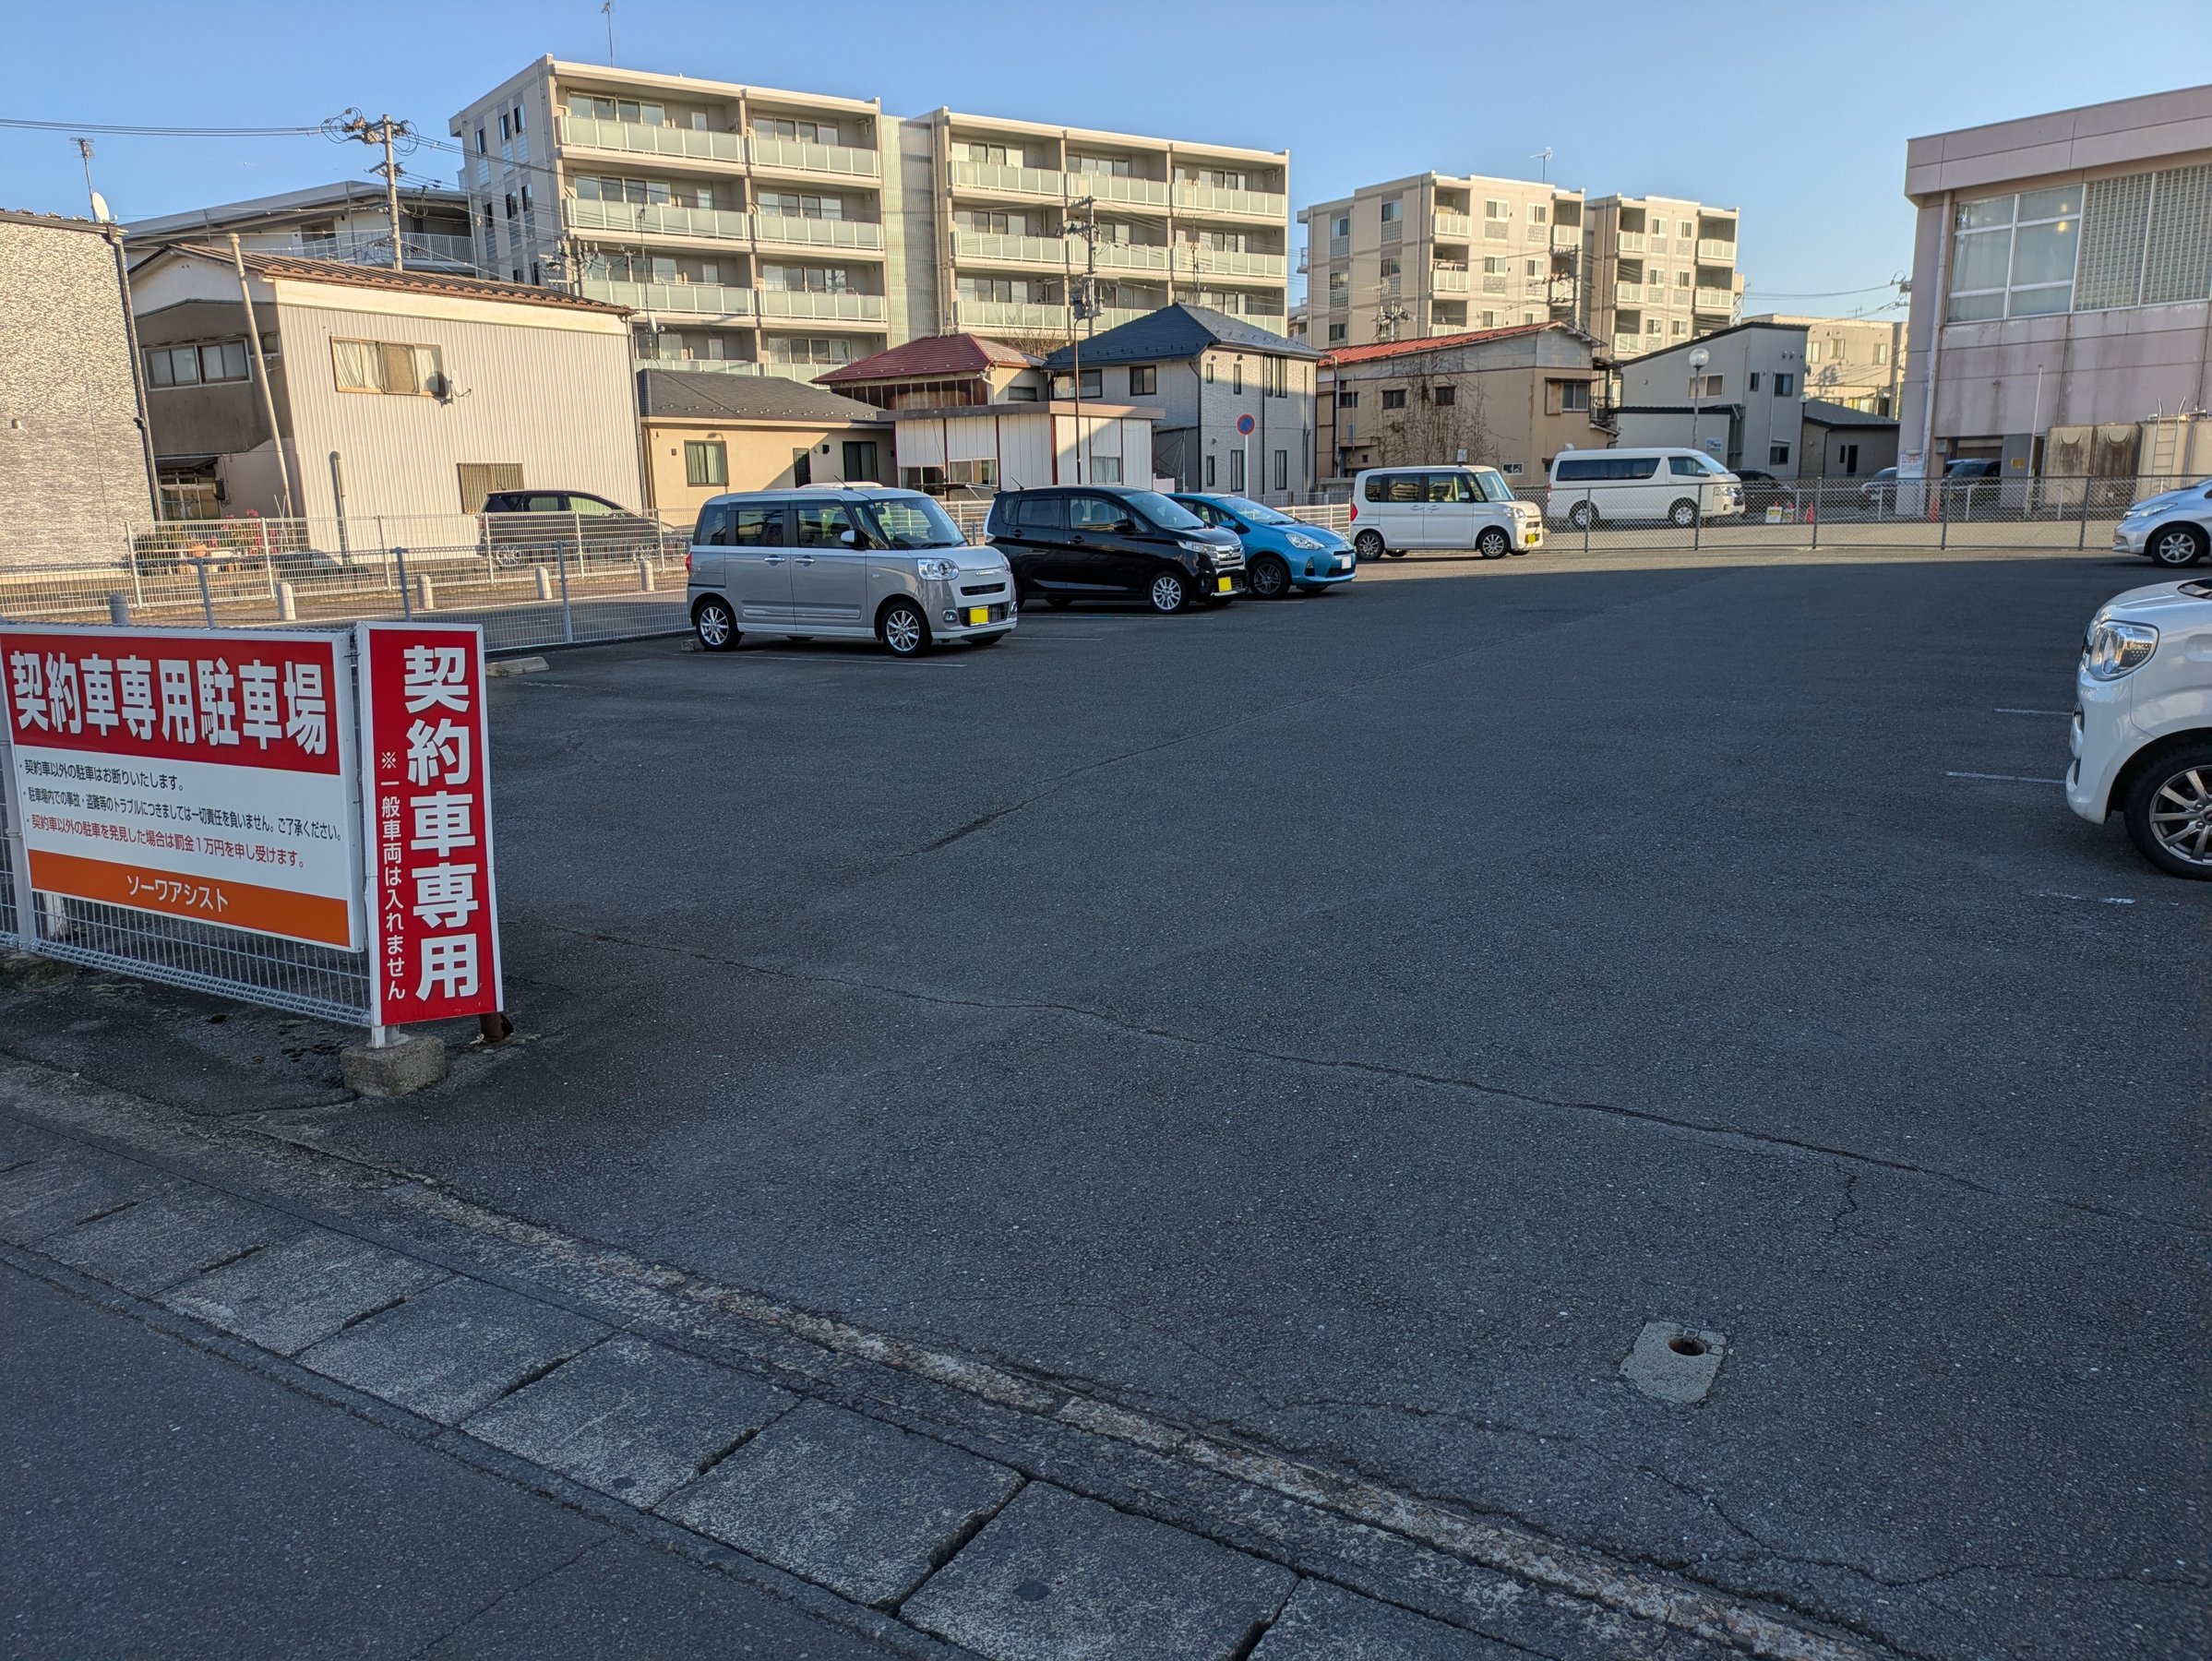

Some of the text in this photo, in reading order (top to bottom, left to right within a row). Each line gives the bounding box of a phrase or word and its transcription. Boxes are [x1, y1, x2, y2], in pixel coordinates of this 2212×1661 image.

[10, 650, 327, 755] 契約車専用駐車場
[403, 644, 479, 1002] 契約車専用
[126, 875, 229, 913] ソーワアシスト
